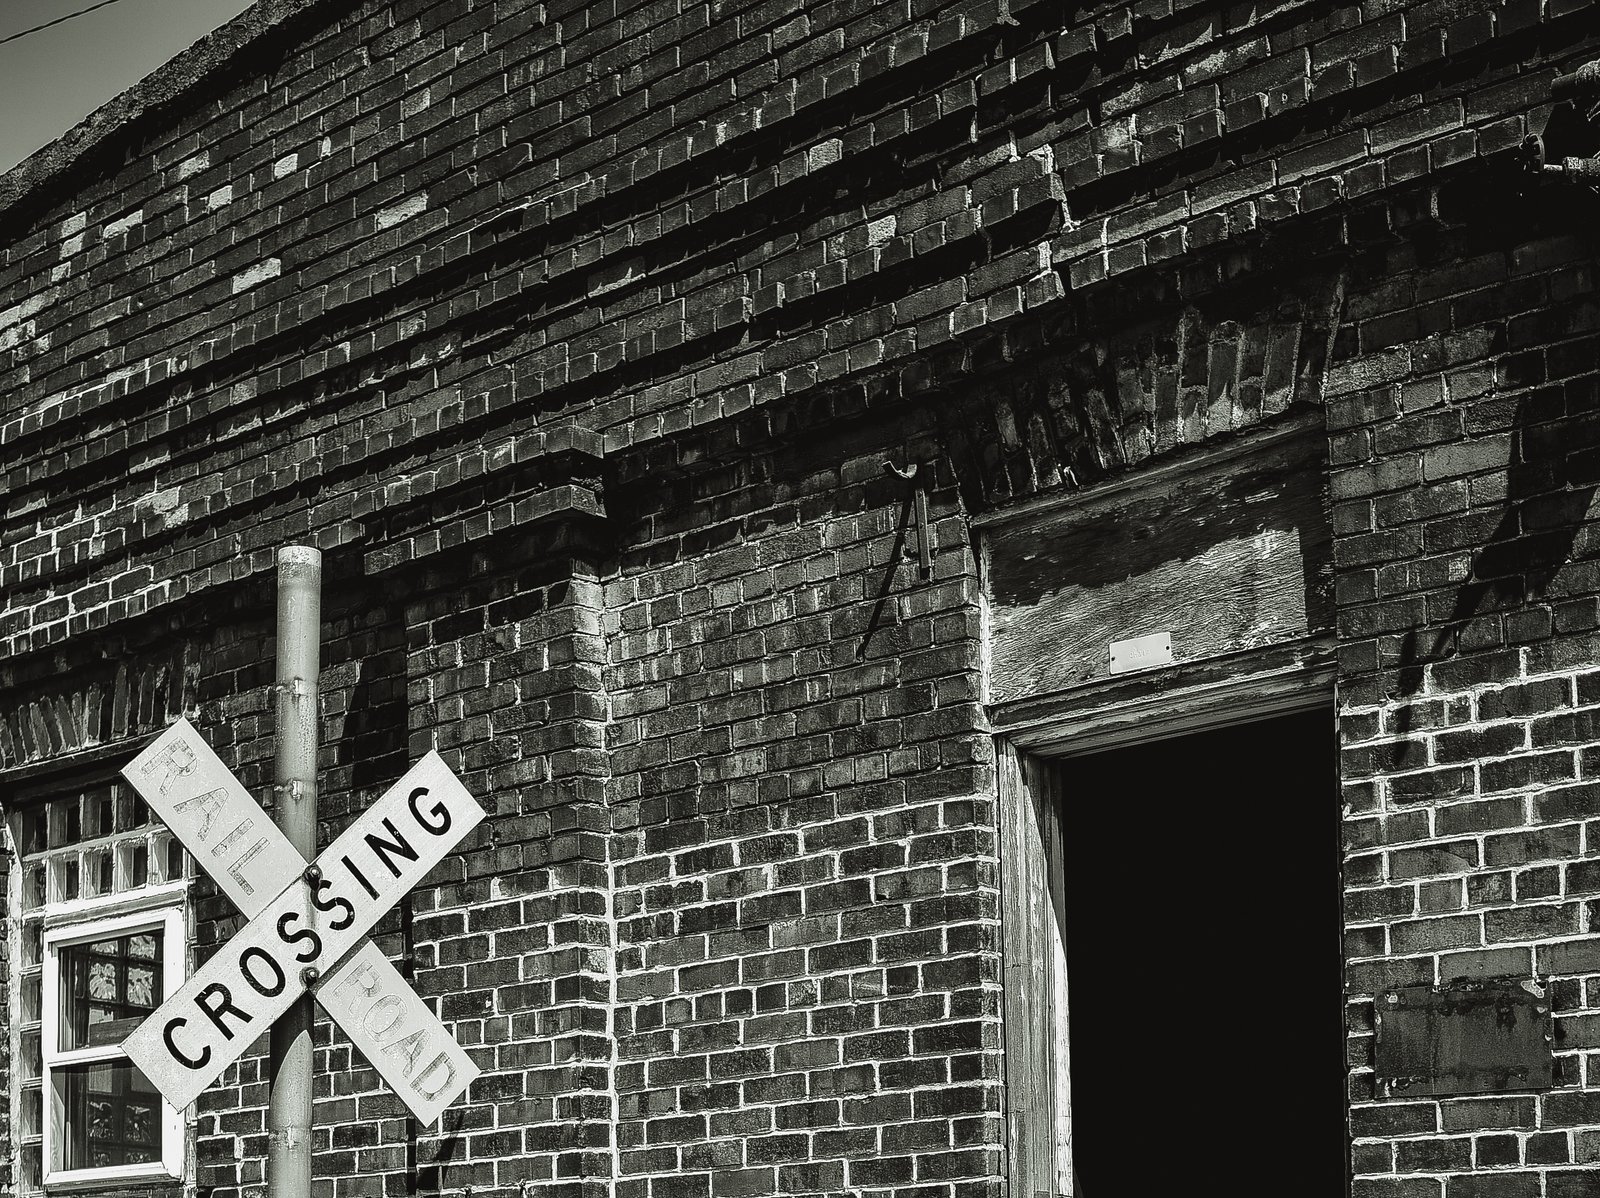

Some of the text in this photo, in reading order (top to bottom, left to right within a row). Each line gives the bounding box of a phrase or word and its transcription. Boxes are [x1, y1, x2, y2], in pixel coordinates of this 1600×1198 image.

[140, 736, 458, 1102] RAIL ROAD
[162, 786, 452, 1070] CROSSING
